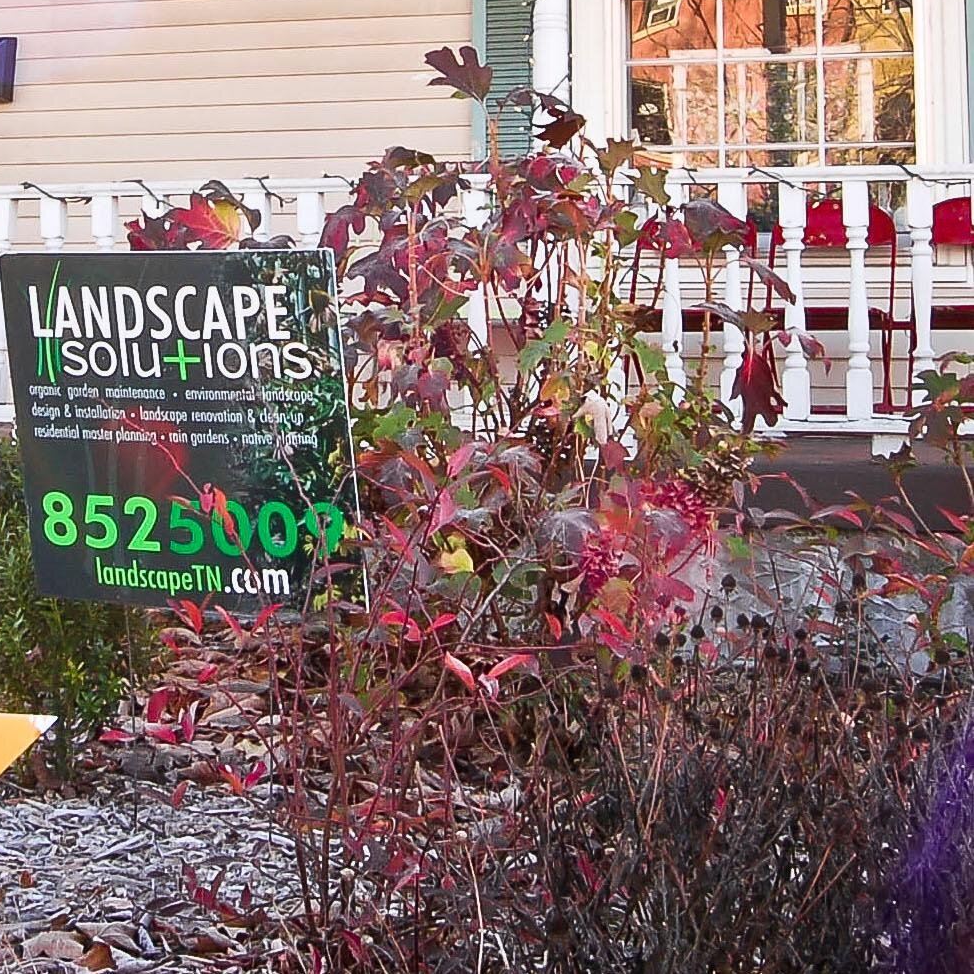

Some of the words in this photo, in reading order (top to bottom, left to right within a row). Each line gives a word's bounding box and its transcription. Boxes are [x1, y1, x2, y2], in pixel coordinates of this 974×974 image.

[28, 285, 291, 341] LANDSCAPE
[29, 384, 61, 399] organic
[67, 383, 99, 400] garden
[105, 385, 165, 400] maintenance
[32, 402, 60, 420] design
[64, 404, 72, 418] &
[75, 404, 126, 420] installation
[139, 406, 187, 424] landscape
[191, 409, 242, 423] renovation
[247, 409, 256, 423] &
[34, 424, 79, 439] residential
[82, 430, 112, 441] master
[115, 427, 157, 445] planning
[168, 429, 187, 443] rain
[192, 429, 230, 446] gardens
[241, 432, 272, 446] native
[96, 556, 290, 597] landscapeTN.com
